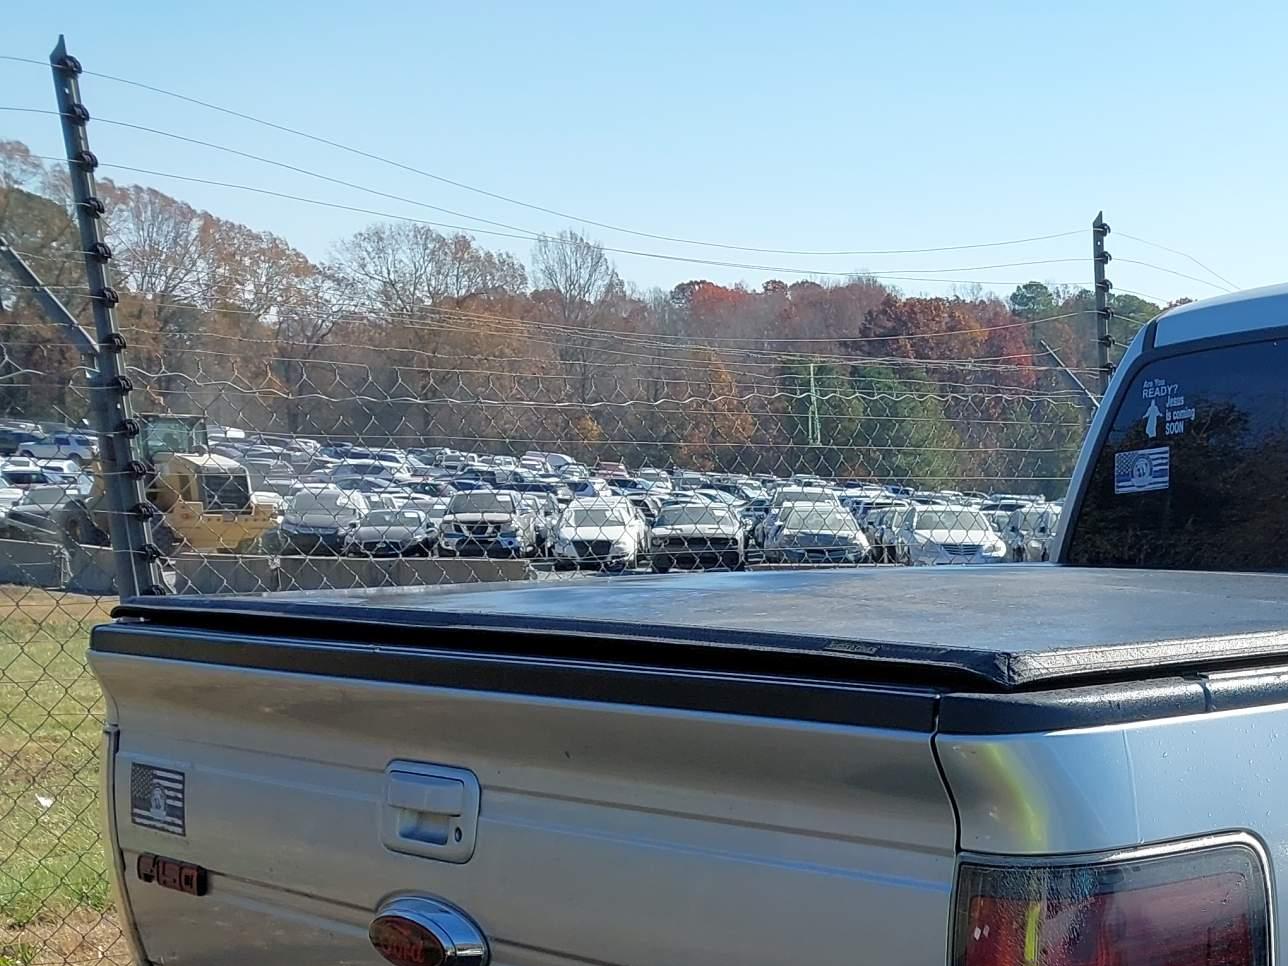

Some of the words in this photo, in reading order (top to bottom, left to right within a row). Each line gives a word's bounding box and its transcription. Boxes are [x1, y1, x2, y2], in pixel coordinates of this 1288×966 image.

[1142, 383, 1178, 399] READY?
[1166, 395, 1184, 408] Jesus
[1173, 407, 1196, 421] coming
[1165, 420, 1184, 435] SOON
